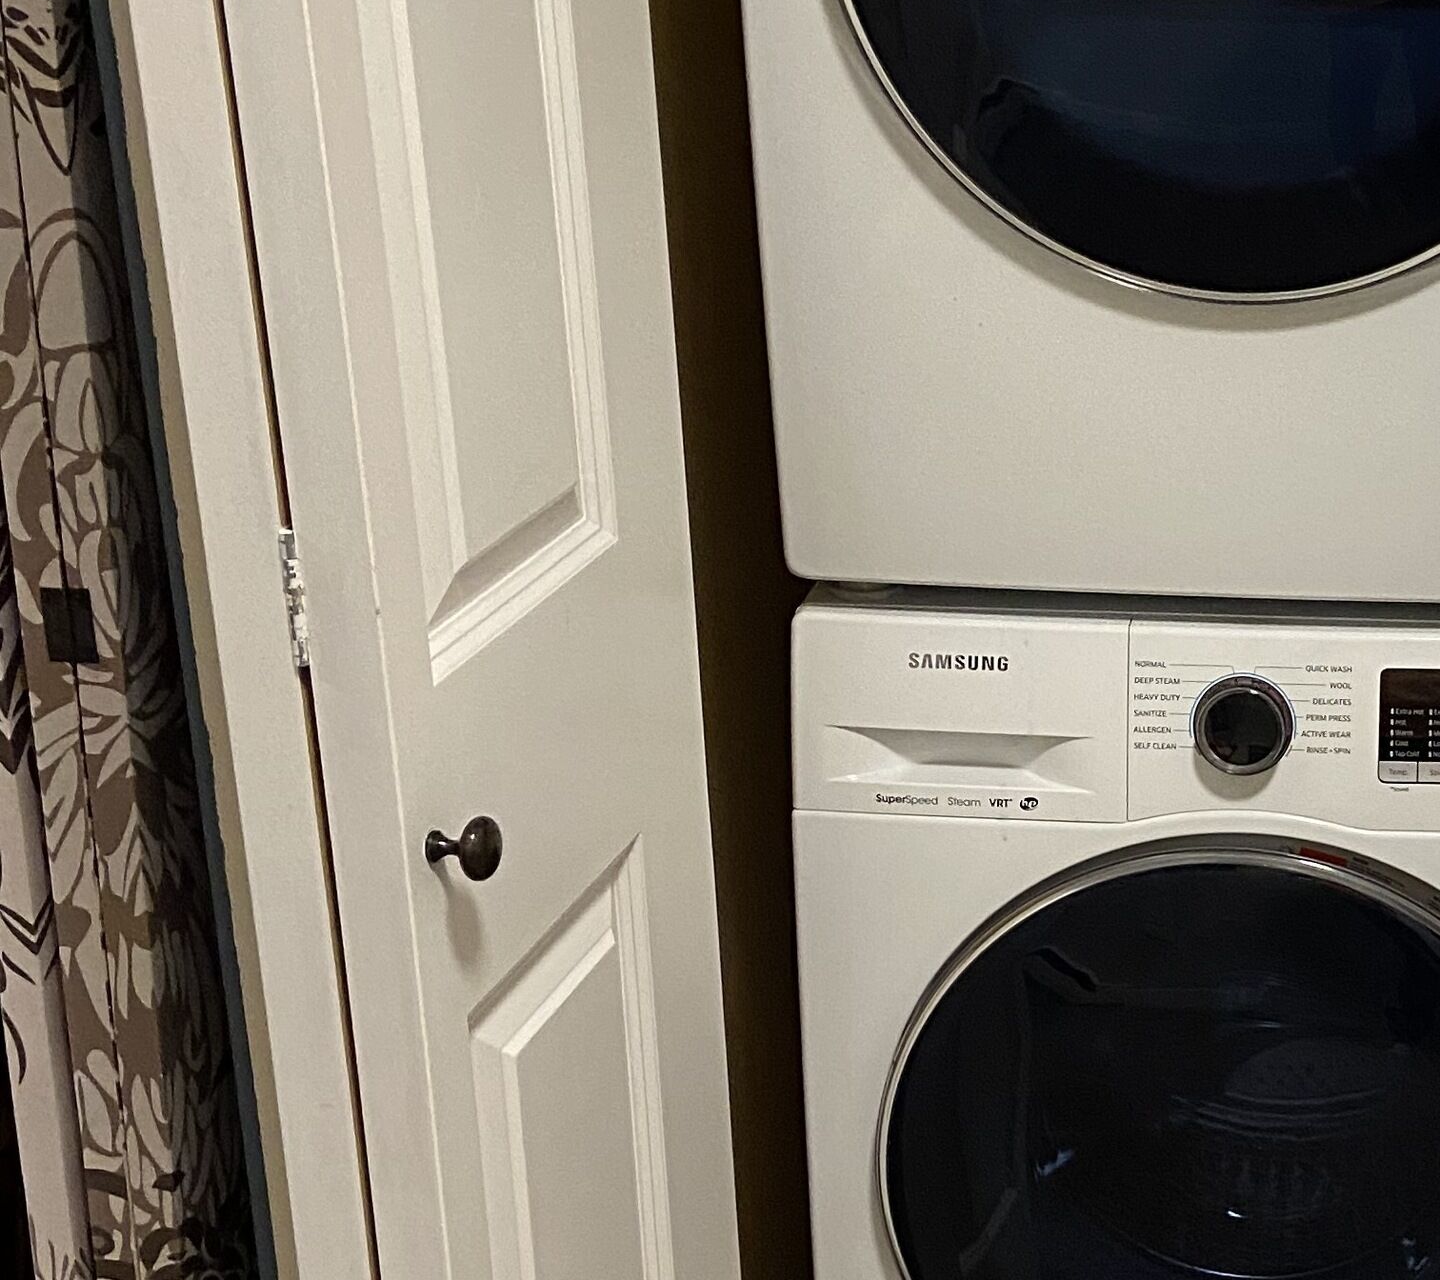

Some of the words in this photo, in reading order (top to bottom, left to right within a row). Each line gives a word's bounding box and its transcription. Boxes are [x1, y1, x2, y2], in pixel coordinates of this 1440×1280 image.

[909, 652, 1009, 671] SAMSUNG
[1134, 661, 1166, 669] NORMAL
[1305, 665, 1329, 673] QUICK
[1330, 665, 1353, 673] WASH
[1134, 677, 1154, 685] DEEP
[1155, 677, 1181, 685] STEAM
[1329, 682, 1353, 690] WOOL
[1133, 694, 1159, 702] HEAVY
[1161, 694, 1181, 702] DUTY
[1312, 698, 1352, 707] DELICATES
[1133, 709, 1167, 718] SANITIZE
[1305, 714, 1328, 722] PERM
[1329, 714, 1352, 723] PRESS
[1133, 726, 1172, 734] ALLERGEN
[1301, 730, 1329, 738] ACTIVE
[1330, 730, 1352, 738] WEAR
[1133, 742, 1152, 750] SELF
[1153, 742, 1177, 750] CLEAN
[876, 793, 939, 806] SuperSpeed
[947, 796, 981, 807] Steam
